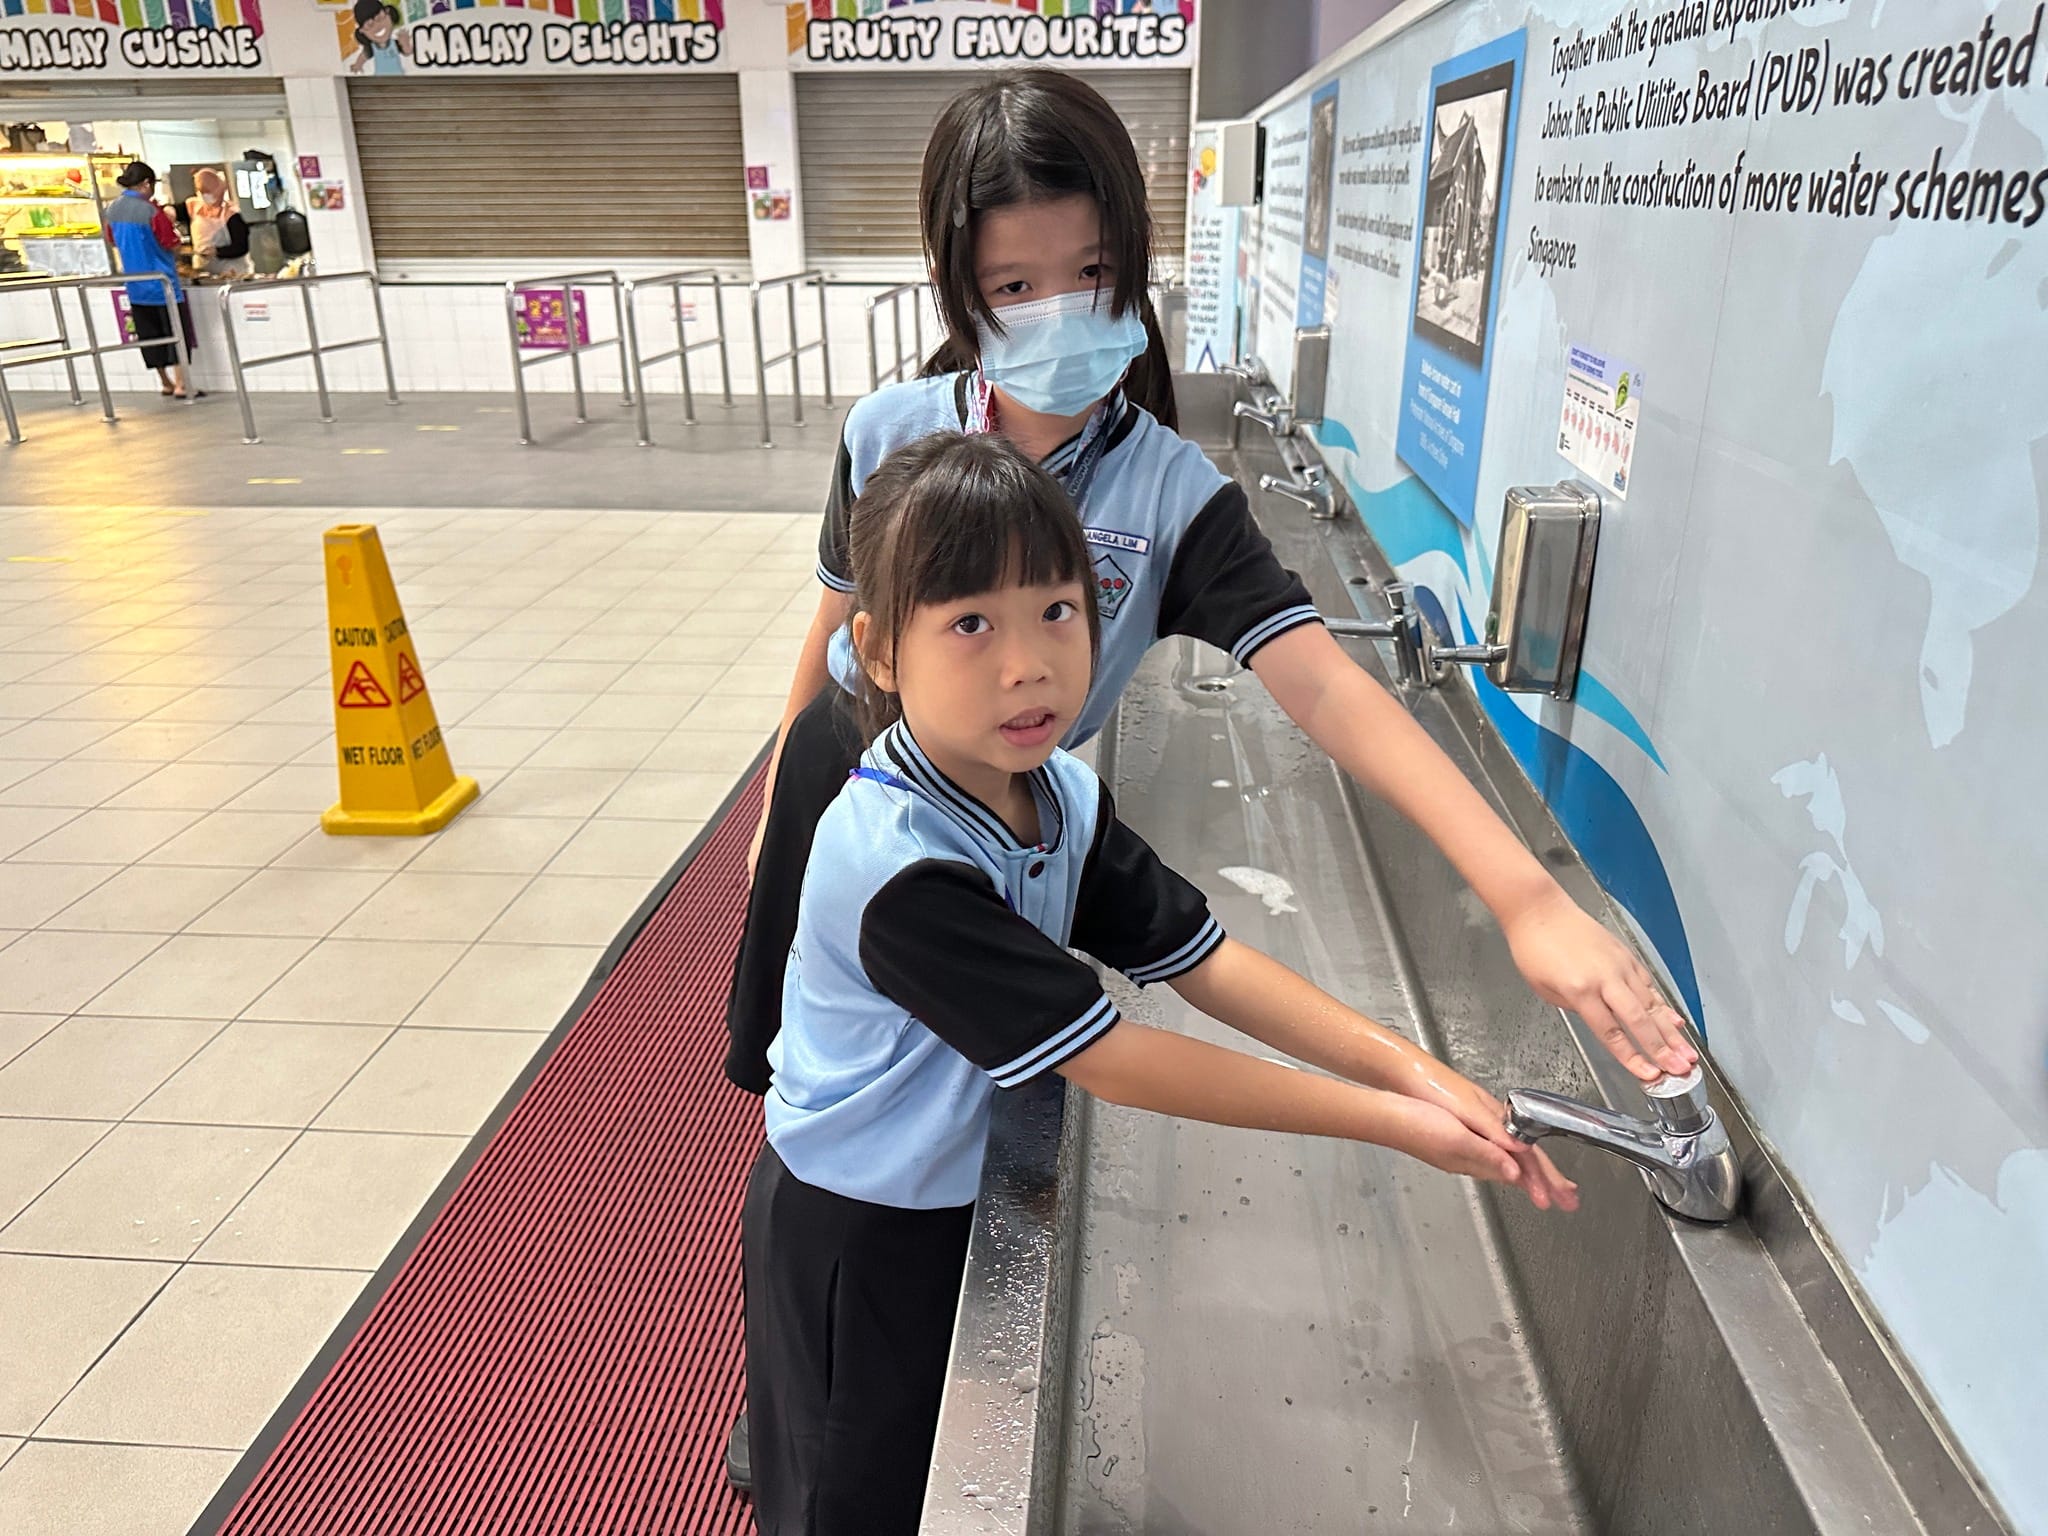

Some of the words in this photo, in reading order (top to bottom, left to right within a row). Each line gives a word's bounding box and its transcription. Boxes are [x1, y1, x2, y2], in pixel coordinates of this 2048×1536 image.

[0, 28, 107, 69] MALAY
[412, 23, 532, 66] MALAY
[1551, 29, 1596, 88] Together
[1597, 14, 1624, 63] with
[1625, 8, 1648, 58] the
[1648, 0, 1710, 68] gradual
[1541, 99, 1573, 140] Johor,
[1574, 94, 1593, 138] the
[1593, 86, 1634, 134] Public
[1635, 78, 1692, 130] Utilities
[1692, 59, 1756, 124] Board
[1755, 38, 1830, 121] (PUB)
[1833, 53, 1893, 106] was
[1898, 2, 2045, 100] created
[1534, 165, 1545, 203] to
[1546, 162, 1584, 205] embark
[1584, 175, 1600, 205] on
[1600, 161, 1621, 206] the
[1623, 157, 1716, 210] construction
[1718, 149, 1746, 215] of
[1742, 171, 1803, 213] more
[1807, 151, 1889, 219] water
[1889, 146, 2048, 229] schemes
[1527, 225, 1577, 278] Singapore.
[1122, 537, 1138, 549] LIM
[334, 627, 378, 648] CAUTION
[342, 747, 366, 766] WET
[369, 747, 405, 766] FLOOR
